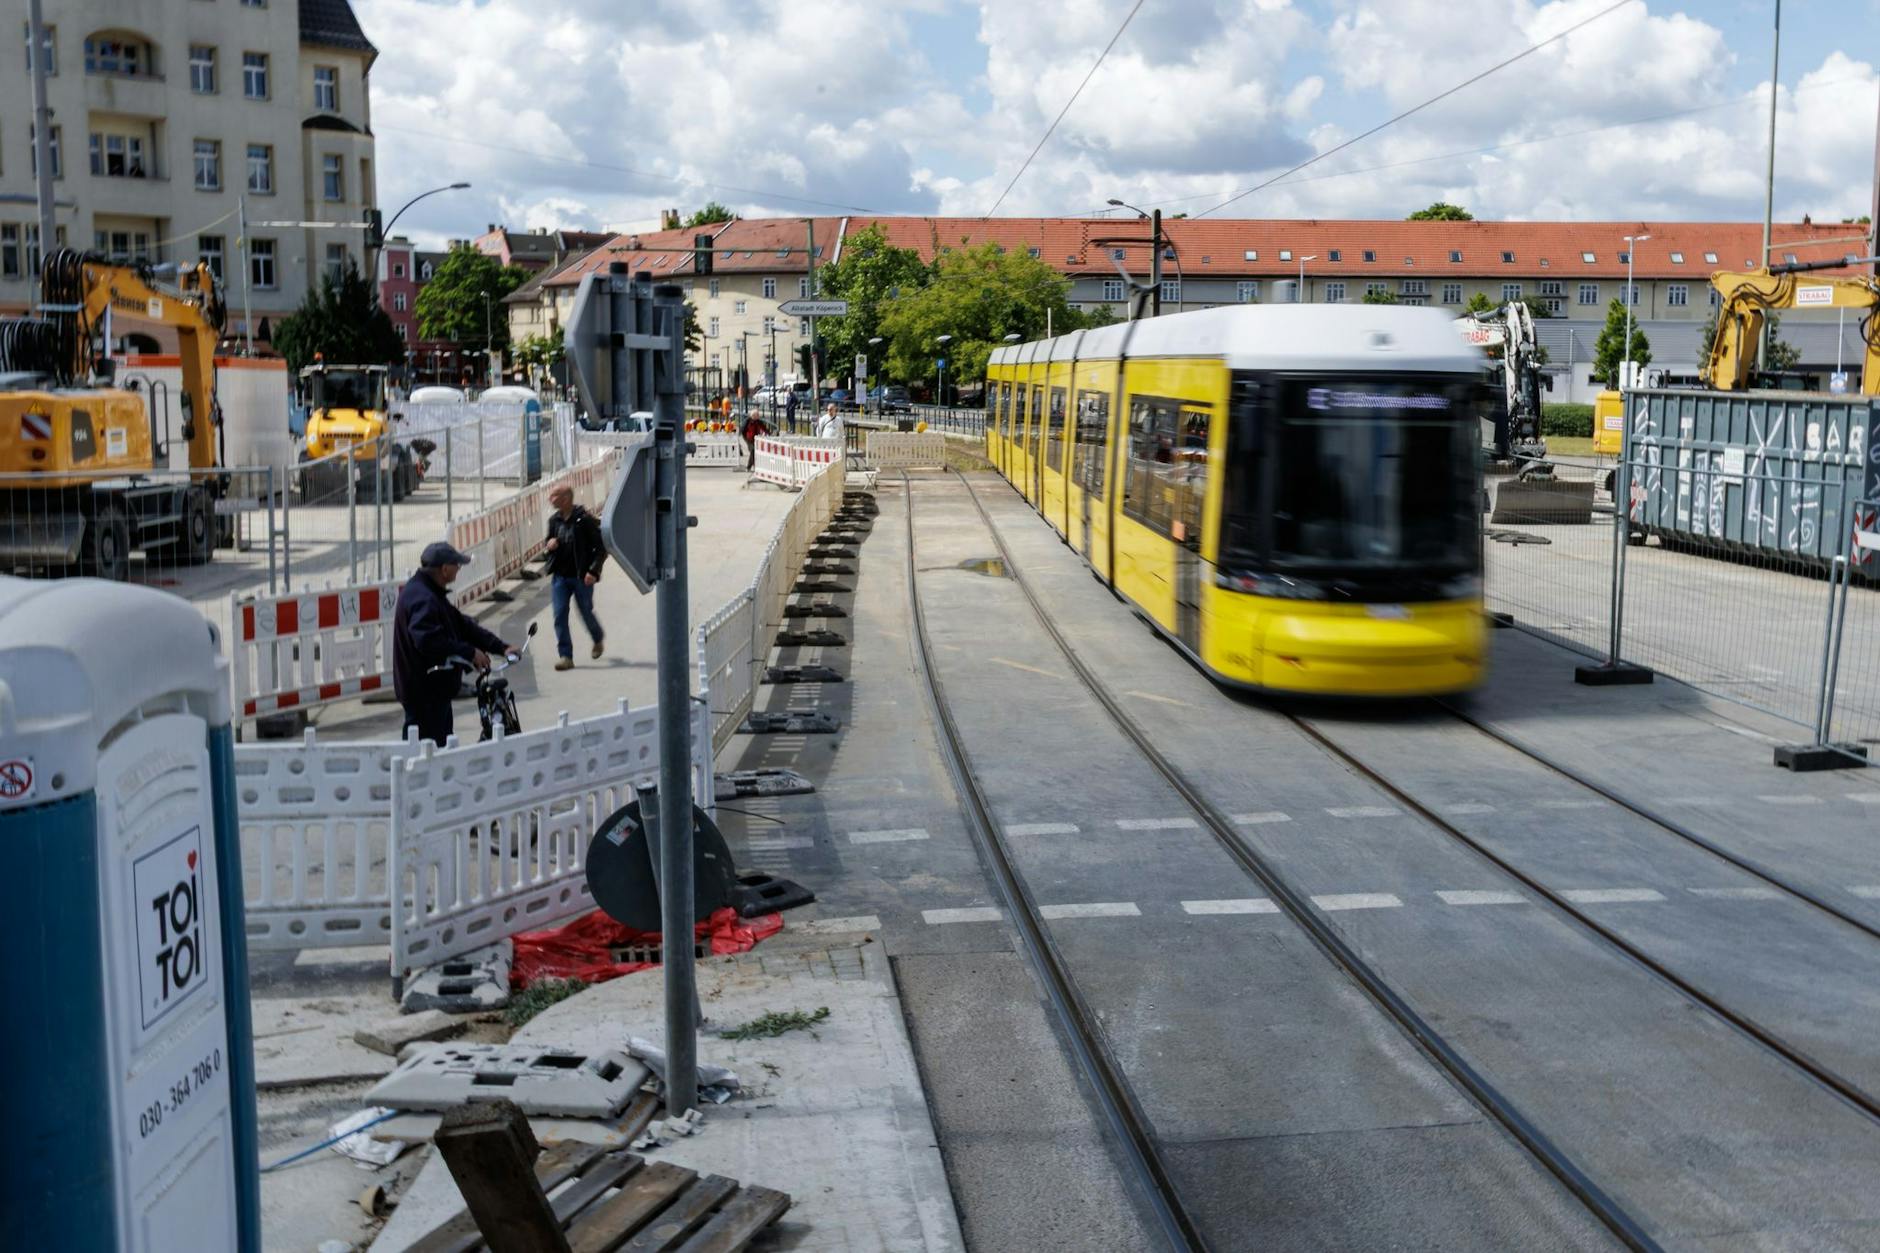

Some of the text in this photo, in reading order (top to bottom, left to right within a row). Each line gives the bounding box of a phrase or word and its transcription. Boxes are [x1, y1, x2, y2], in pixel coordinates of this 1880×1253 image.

[156, 926, 200, 1000] TOI
[139, 1100, 162, 1138] 030
[168, 1075, 190, 1112] 364
[192, 1056, 212, 1089] 706
[213, 1048, 220, 1071] 0
